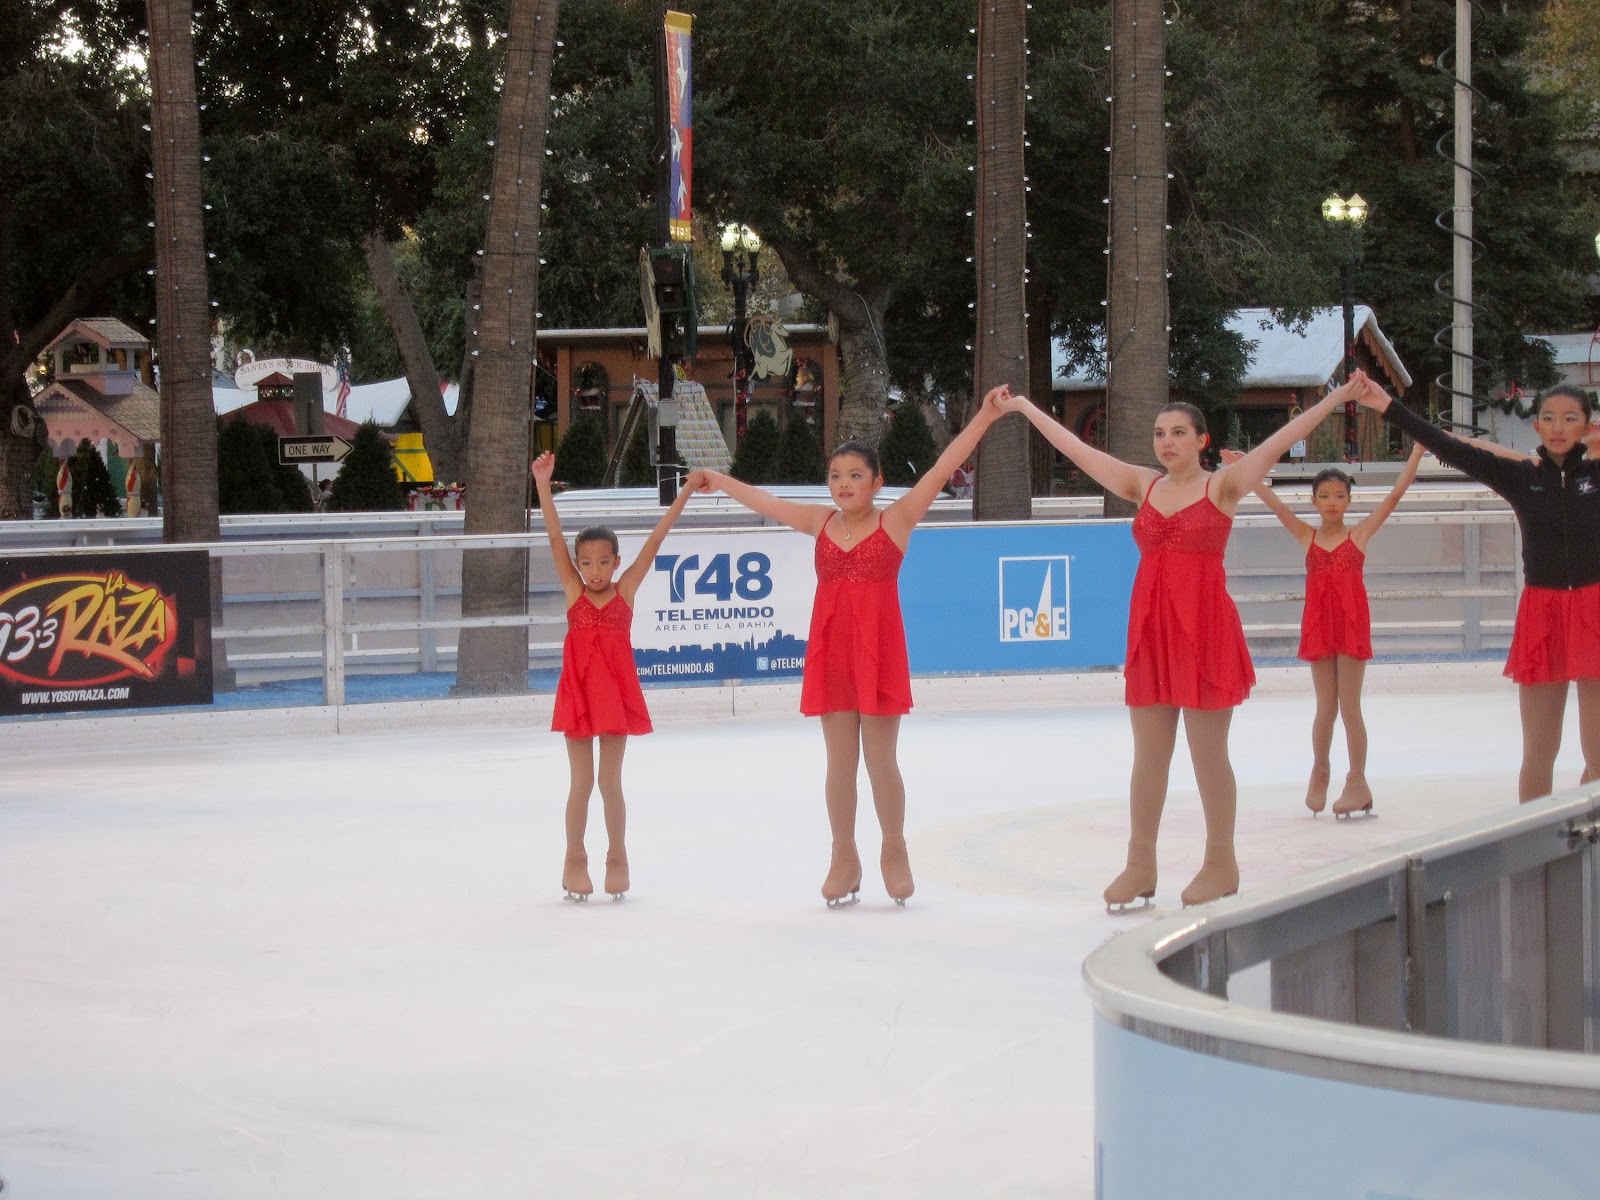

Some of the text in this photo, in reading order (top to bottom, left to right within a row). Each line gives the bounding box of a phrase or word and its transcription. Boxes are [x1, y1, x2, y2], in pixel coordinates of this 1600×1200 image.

[288, 444, 331, 456] ONE WAY
[104, 572, 126, 595] LA
[654, 606, 775, 622] TELEMUNDO
[1003, 607, 1066, 640] PG&E
[46, 584, 166, 677] RAZA
[655, 621, 775, 632] AREA DE LA BAHIA
